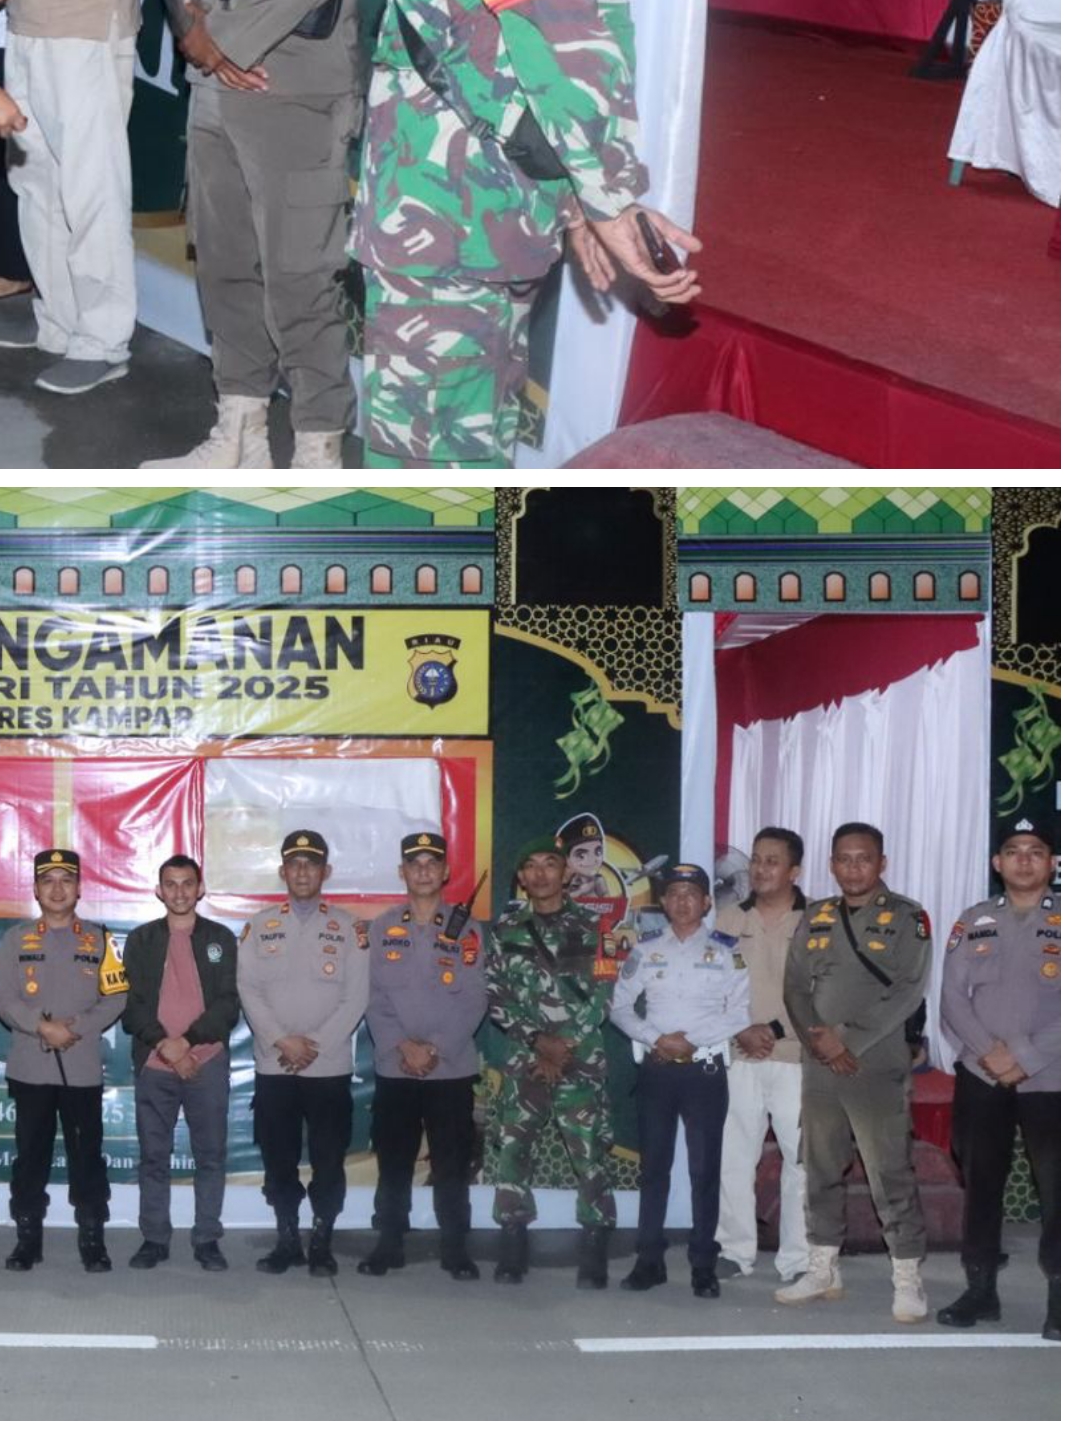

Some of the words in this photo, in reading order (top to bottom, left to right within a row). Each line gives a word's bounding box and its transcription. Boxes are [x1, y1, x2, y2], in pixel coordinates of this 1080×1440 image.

[413, 636, 456, 648] RIAU
[44, 675, 204, 700] TAHUN
[216, 675, 331, 701] 2025
[62, 705, 195, 730] KAMPAR
[318, 932, 345, 943] POLRI
[1036, 929, 1061, 939] POL
[105, 972, 119, 986] KA
